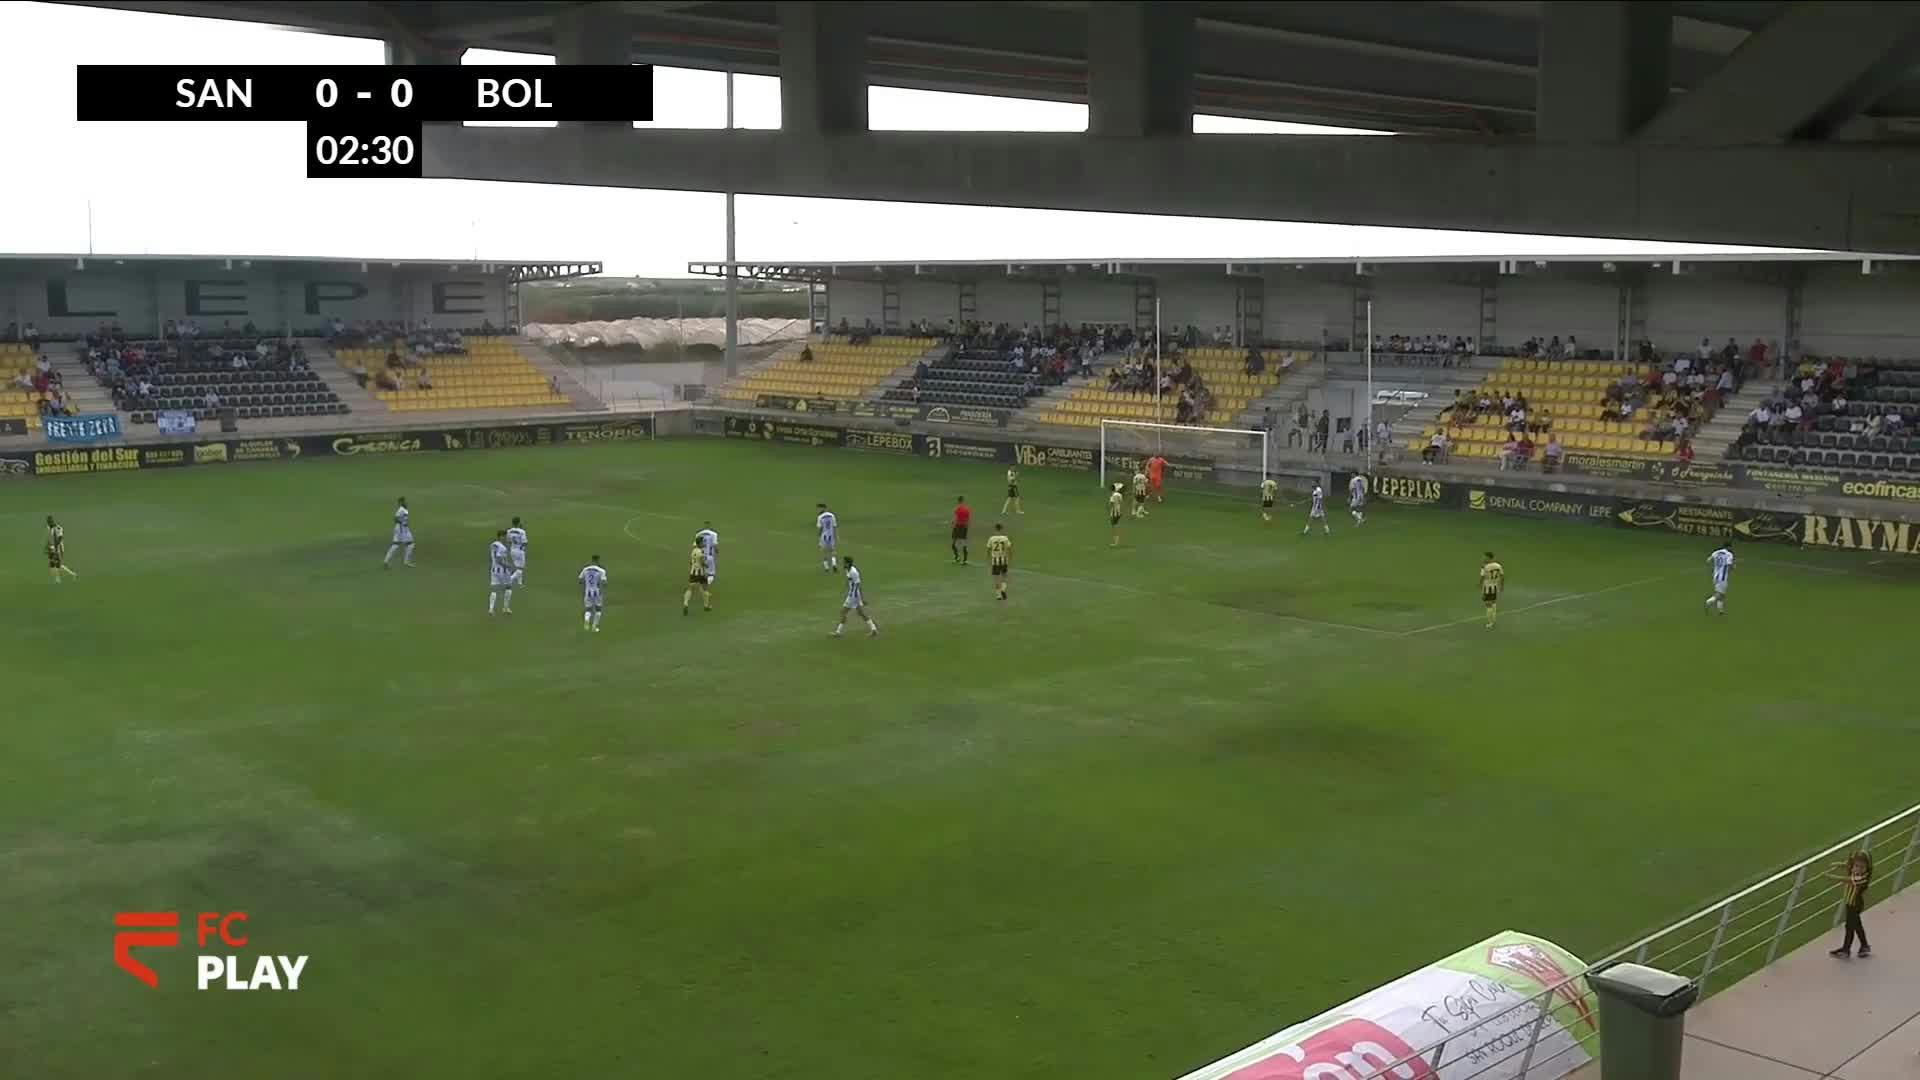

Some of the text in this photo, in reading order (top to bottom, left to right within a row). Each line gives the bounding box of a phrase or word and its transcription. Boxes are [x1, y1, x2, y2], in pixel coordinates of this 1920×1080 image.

[46, 279, 485, 317] LEPE
[867, 435, 913, 450] LEPEBOX
[35, 450, 89, 467] Gestión
[92, 449, 114, 464] del
[116, 447, 139, 461] Sur
[1373, 477, 1441, 500] LEPEPLAS
[1490, 496, 1527, 510] DENTAL
[1528, 500, 1583, 515] COMPANY
